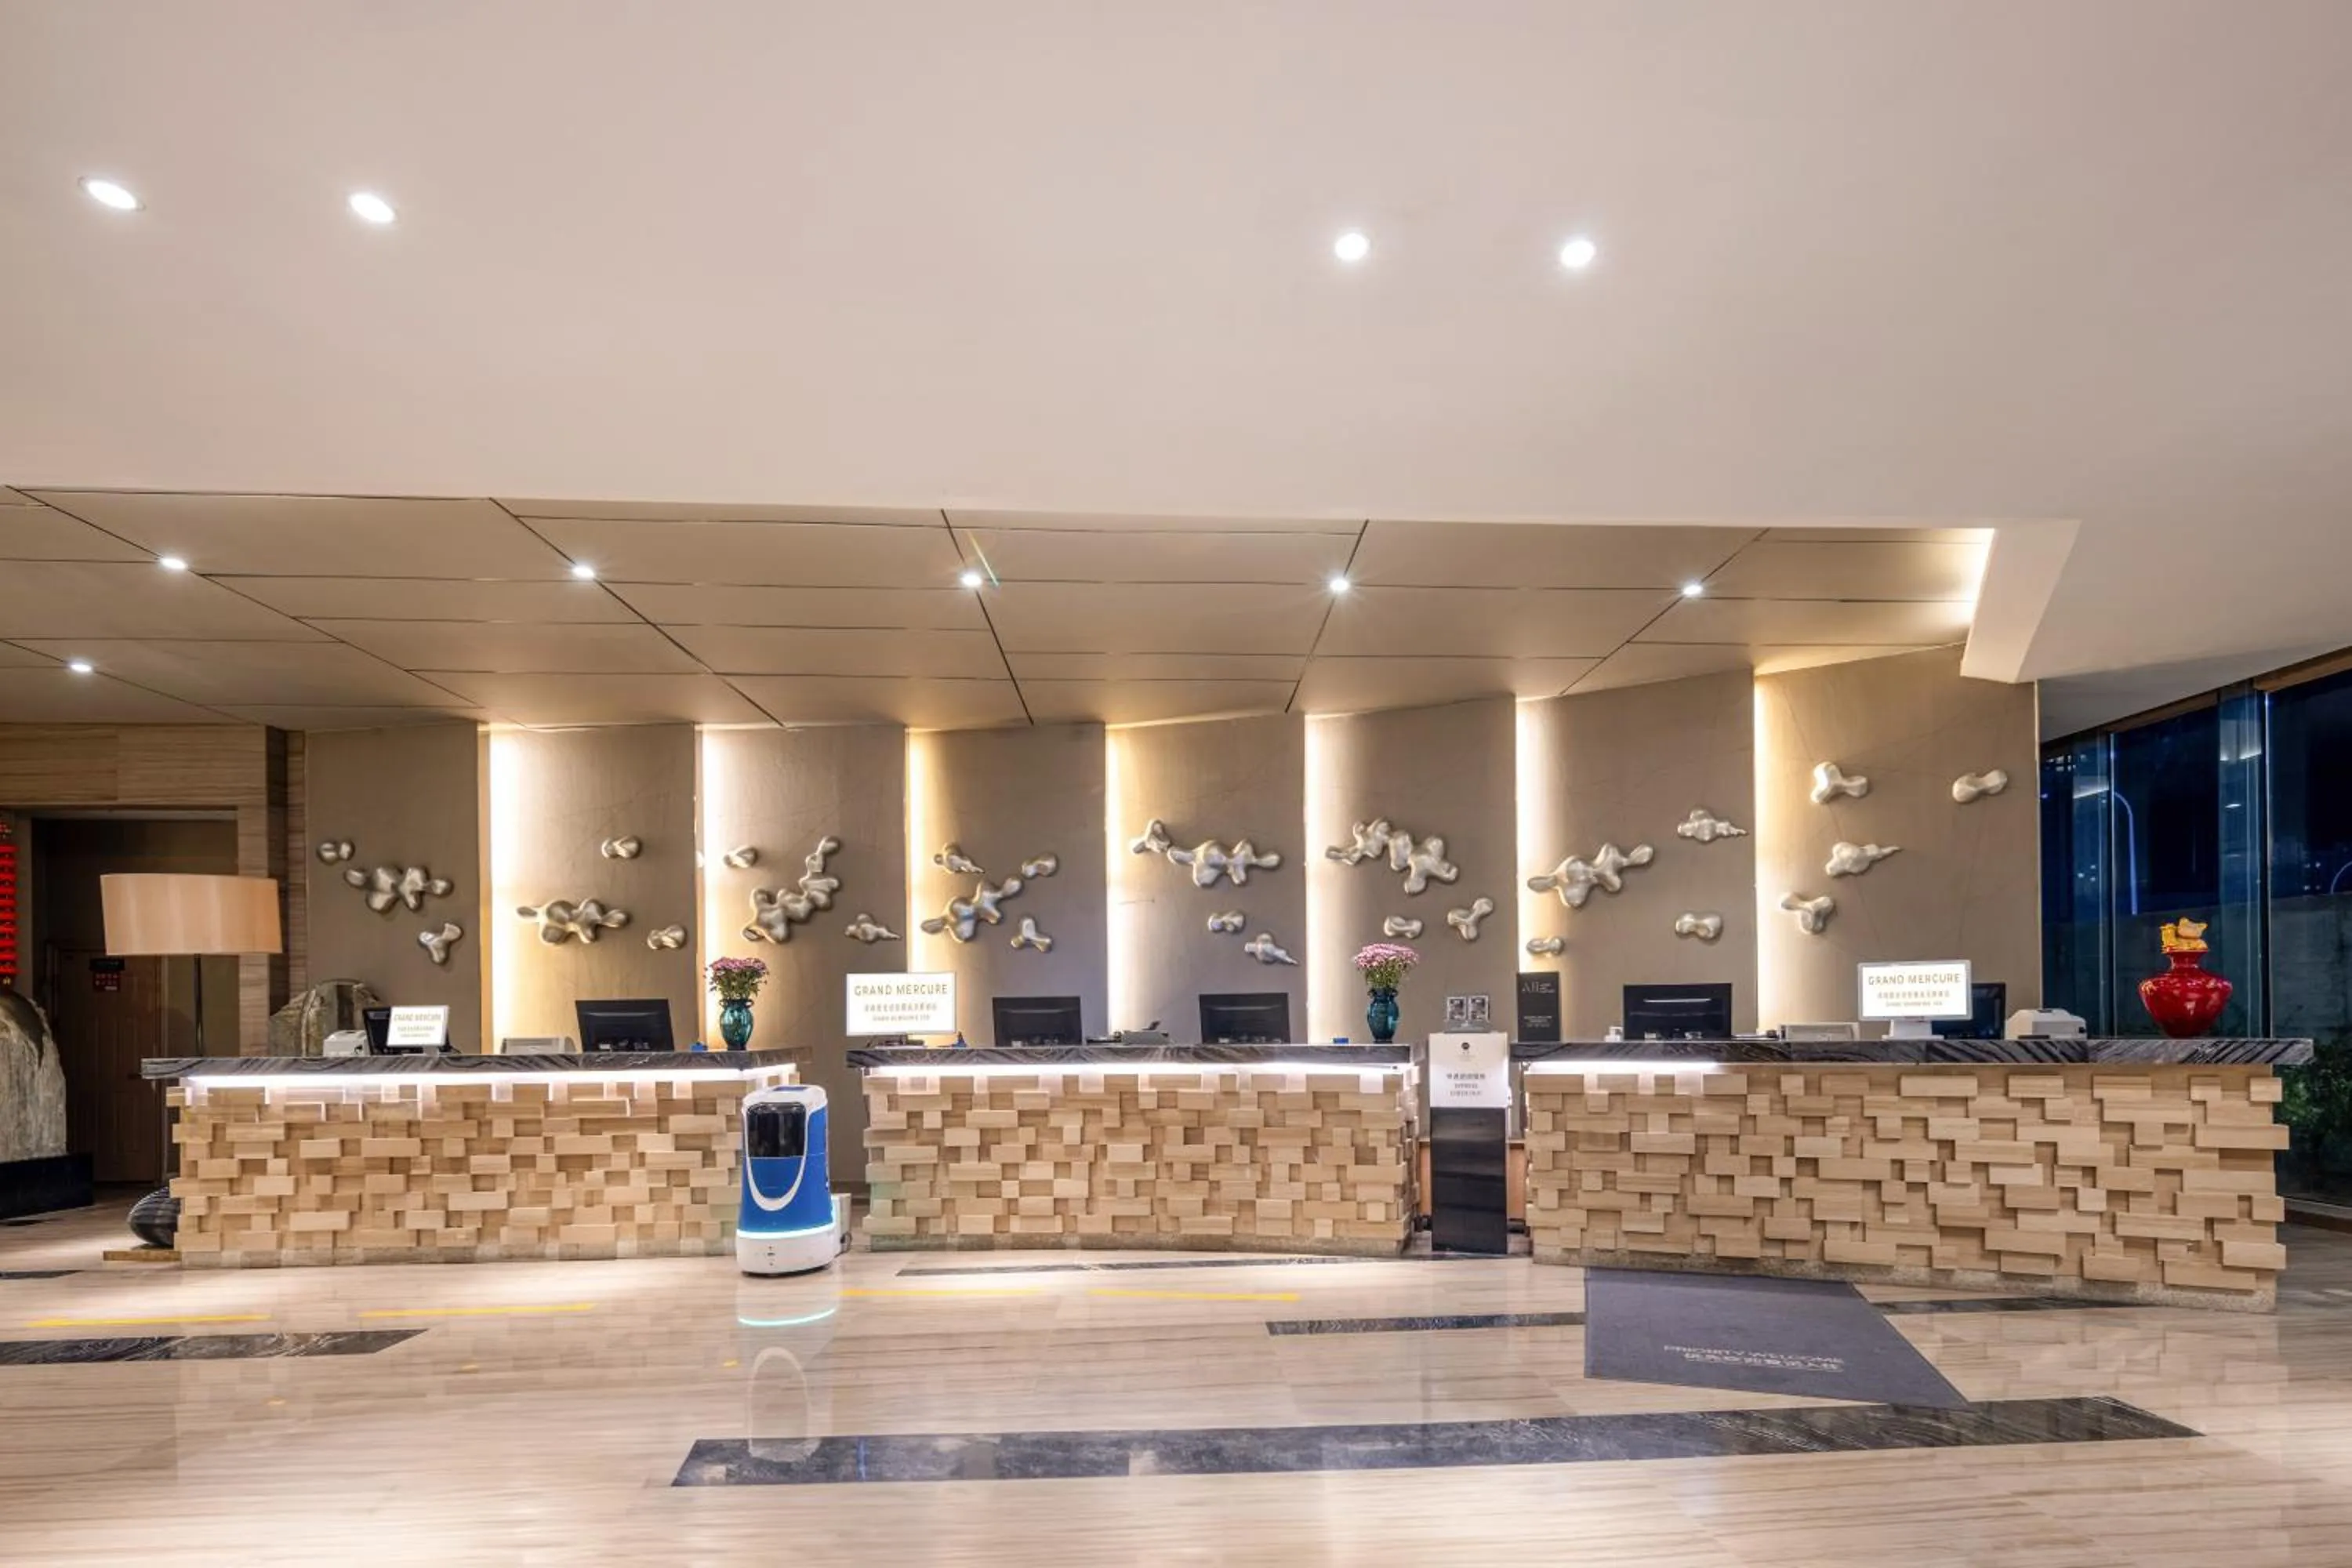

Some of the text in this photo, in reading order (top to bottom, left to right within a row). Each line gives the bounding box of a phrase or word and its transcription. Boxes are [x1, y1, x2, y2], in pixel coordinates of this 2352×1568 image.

[1868, 973, 1961, 985] GRAND MERCURE
[854, 983, 948, 996] GRAND MERCURE
